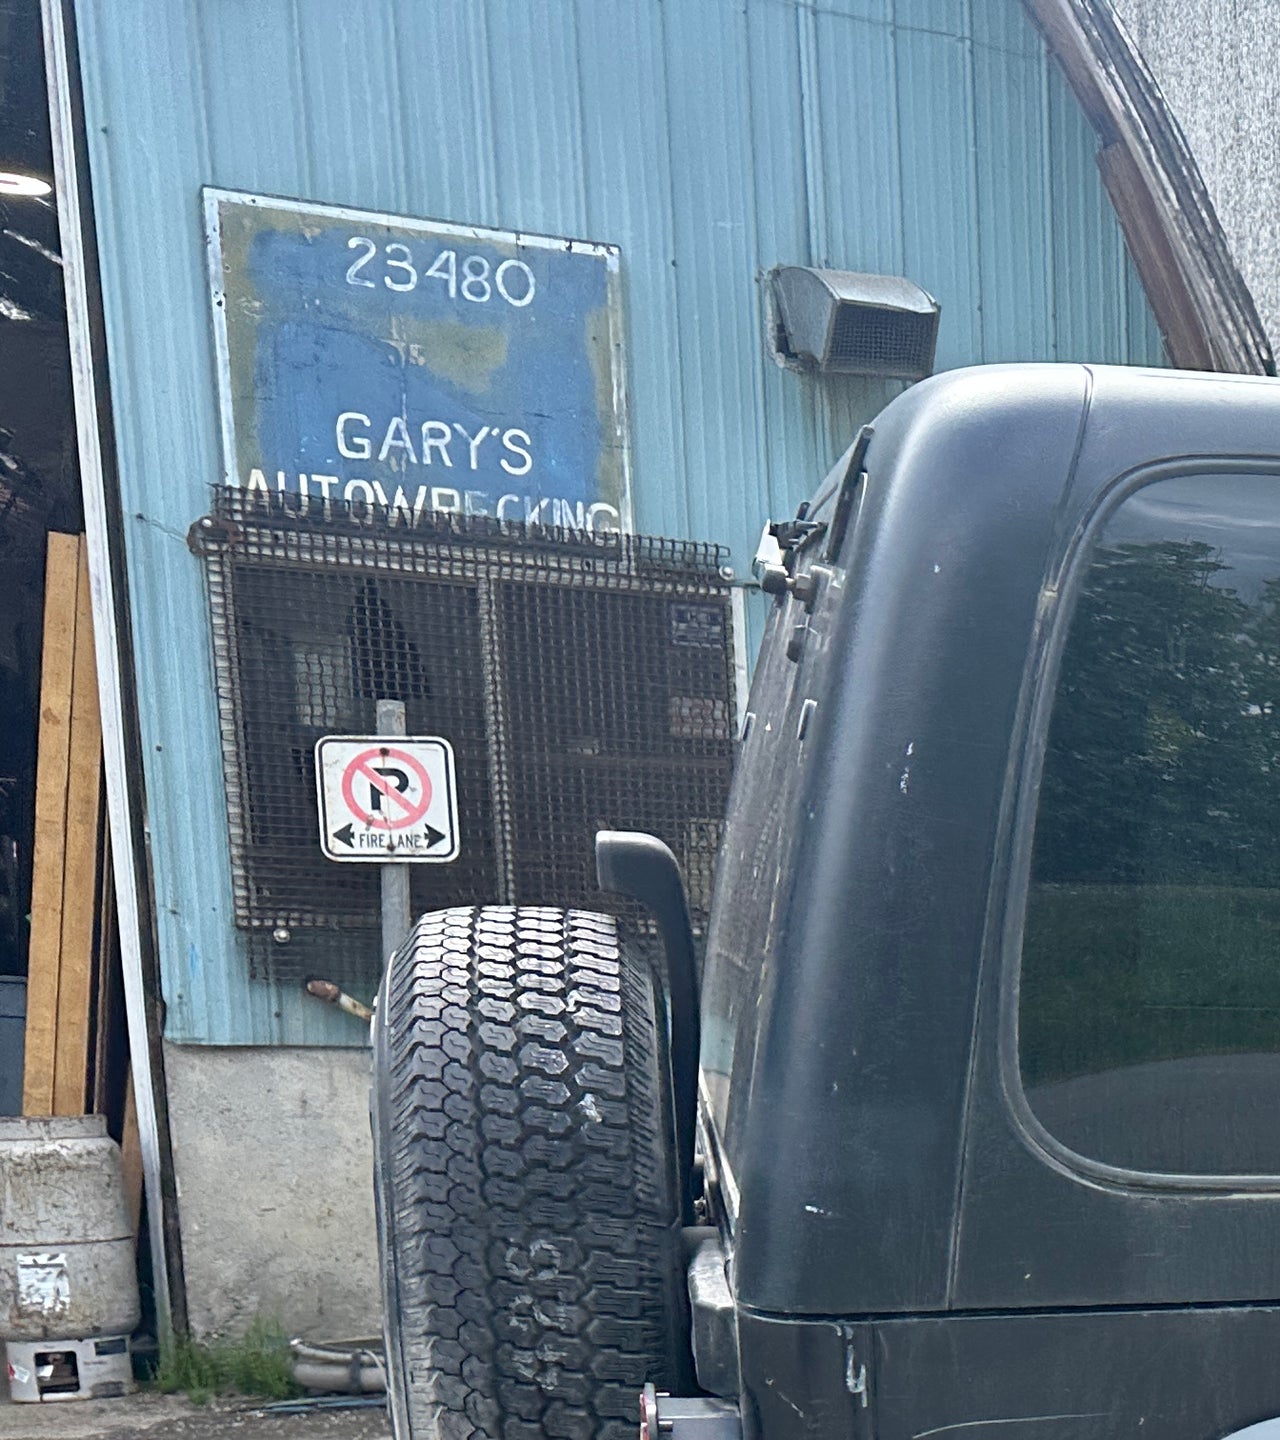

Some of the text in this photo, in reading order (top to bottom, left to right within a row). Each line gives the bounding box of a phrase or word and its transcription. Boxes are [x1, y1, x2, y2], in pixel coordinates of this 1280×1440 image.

[344, 235, 536, 308] 23480
[335, 410, 534, 477] GARY'S
[359, 833, 386, 849] FIRE
